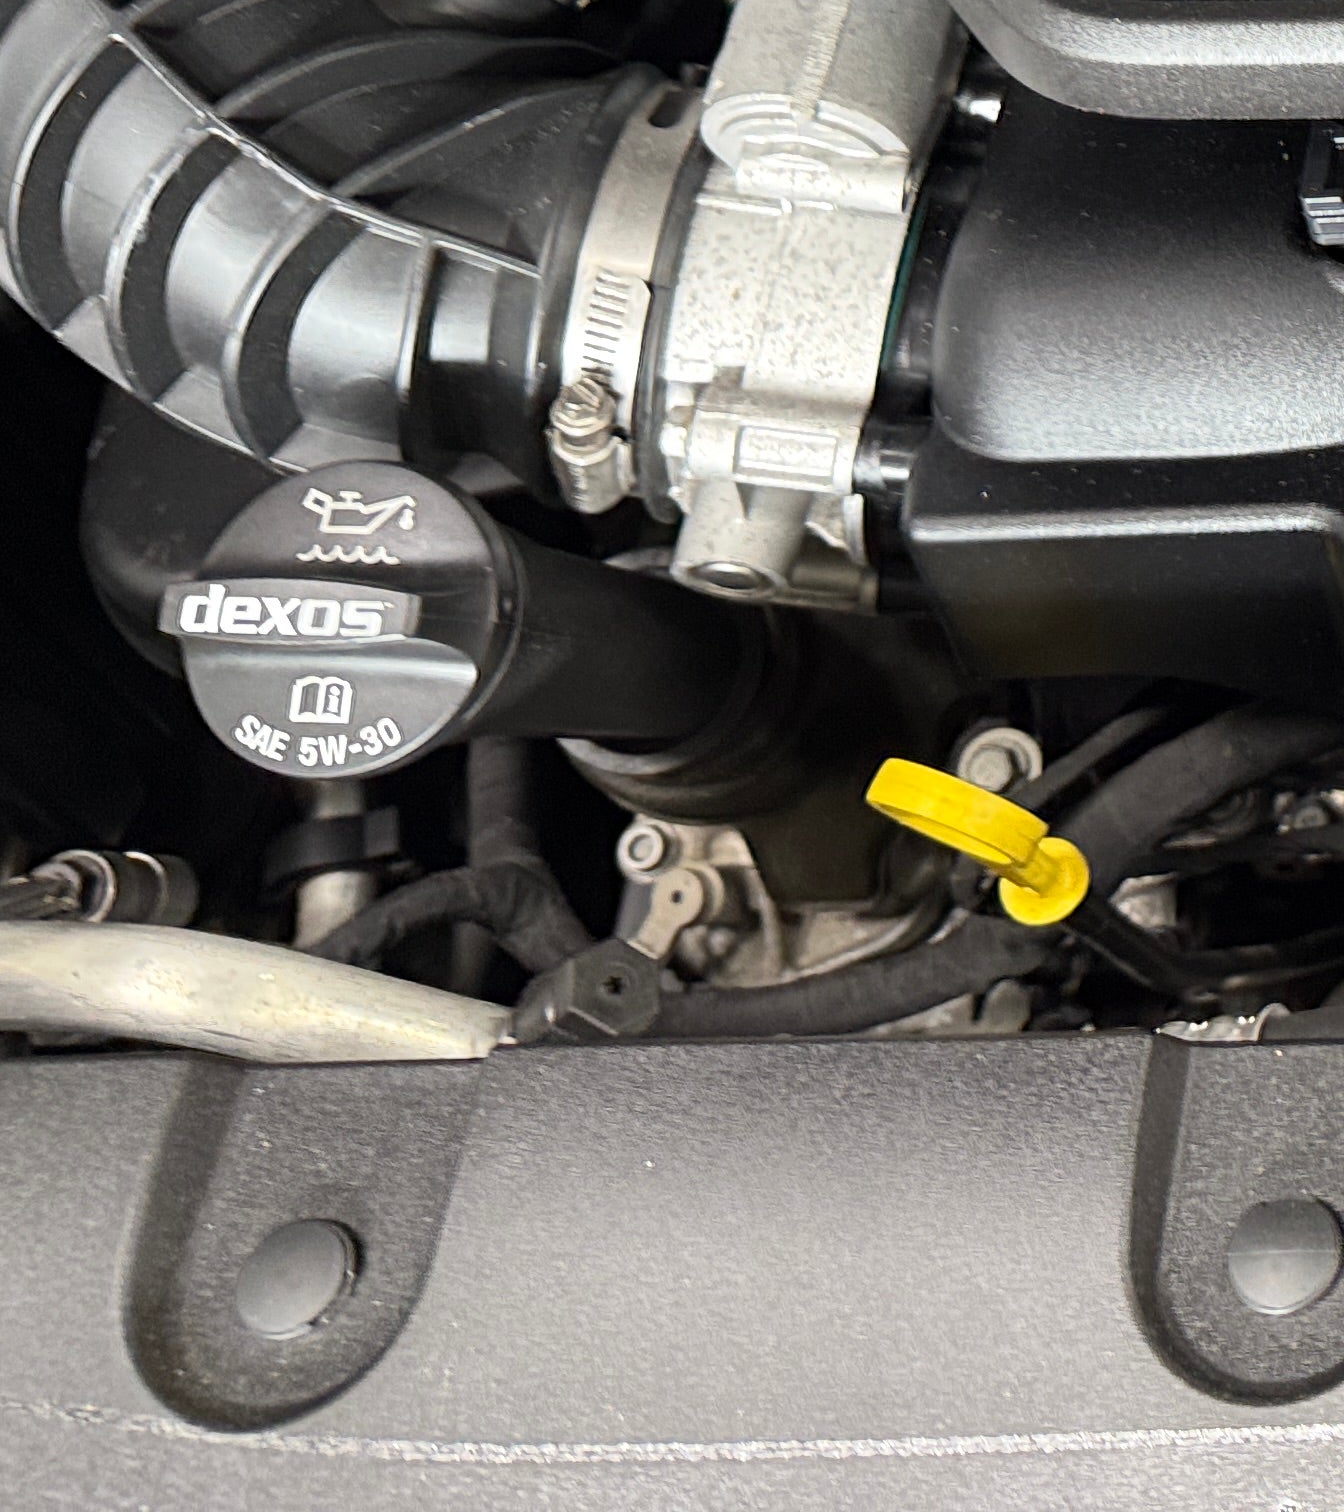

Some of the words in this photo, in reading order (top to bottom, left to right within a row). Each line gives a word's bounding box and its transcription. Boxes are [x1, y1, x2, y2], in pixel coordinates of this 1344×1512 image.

[179, 584, 385, 637] dexos
[234, 714, 291, 762] SAE
[299, 717, 402, 767] 5W-30
